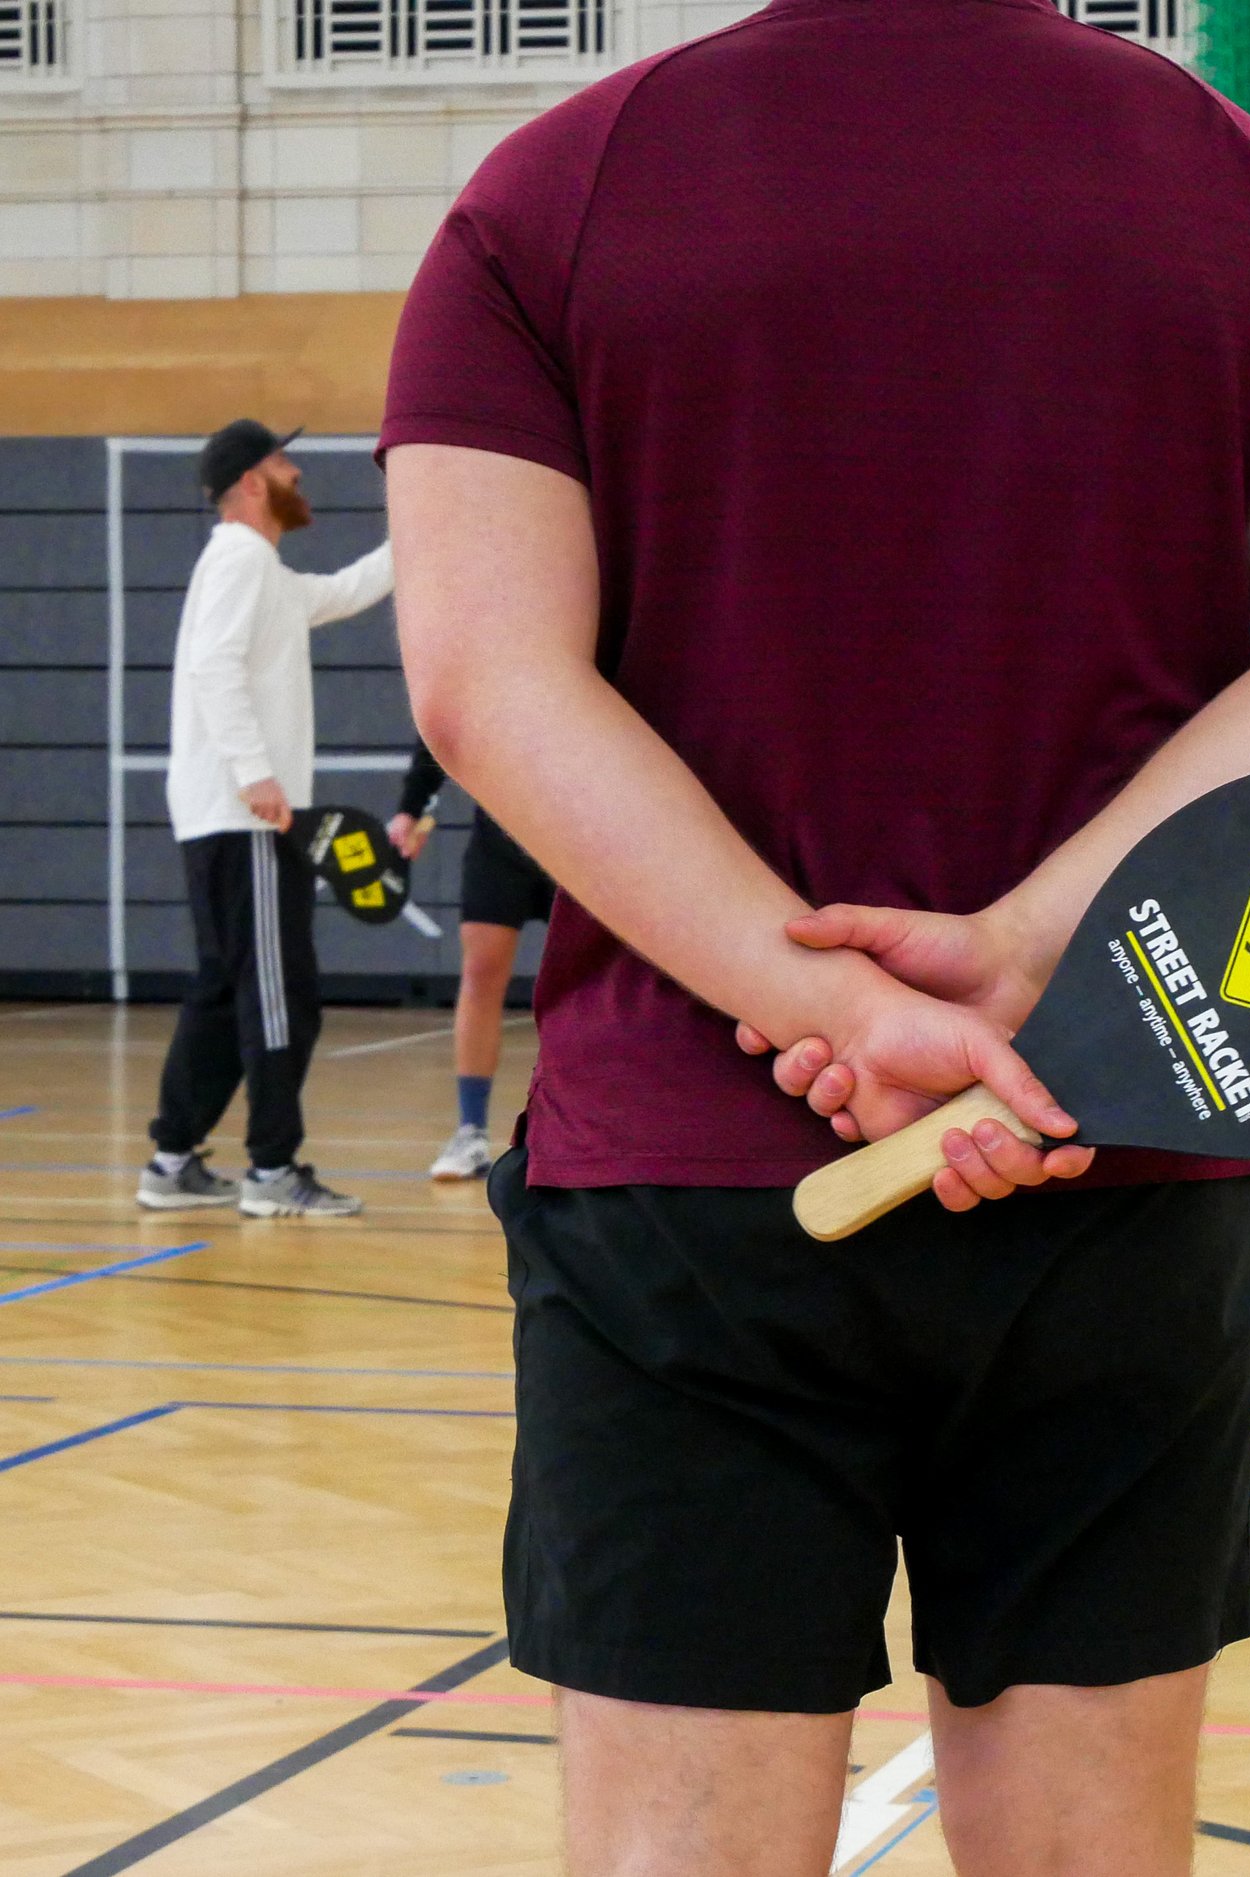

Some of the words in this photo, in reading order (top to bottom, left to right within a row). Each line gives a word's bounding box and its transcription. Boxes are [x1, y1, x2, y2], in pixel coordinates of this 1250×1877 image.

[1128, 898, 1208, 1006] STREET
[1107, 938, 1140, 984] anyone
[1139, 997, 1173, 1047] anytime
[1172, 1060, 1212, 1121] anywhere
